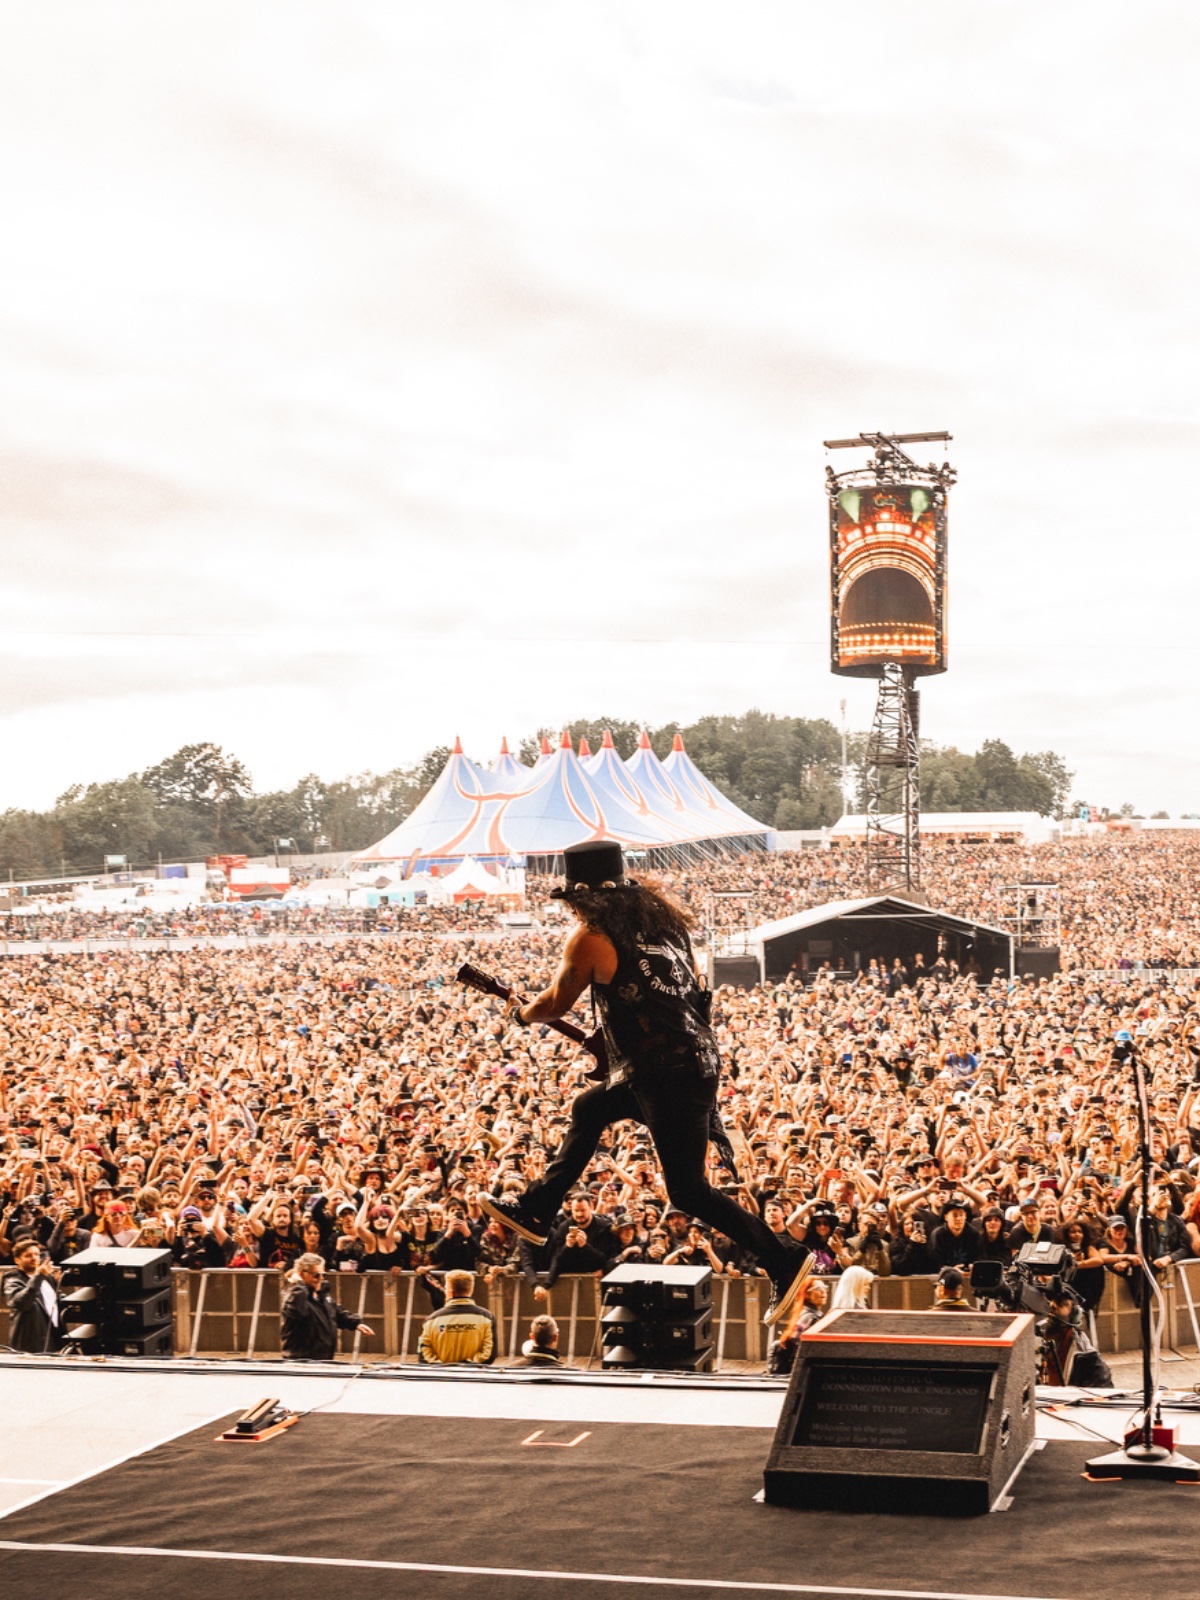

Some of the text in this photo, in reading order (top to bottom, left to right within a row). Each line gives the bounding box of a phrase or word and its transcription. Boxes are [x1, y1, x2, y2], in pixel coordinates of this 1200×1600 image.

[446, 1323, 477, 1331] SHOWSEC
[821, 1382, 891, 1393] DONNINGTON
[925, 1386, 978, 1396] ENGLAND
[816, 1401, 953, 1417] WELCOME TO THE JUNGLE
[811, 1422, 907, 1437] Welcome to the jungle
[878, 1437, 907, 1447] games
